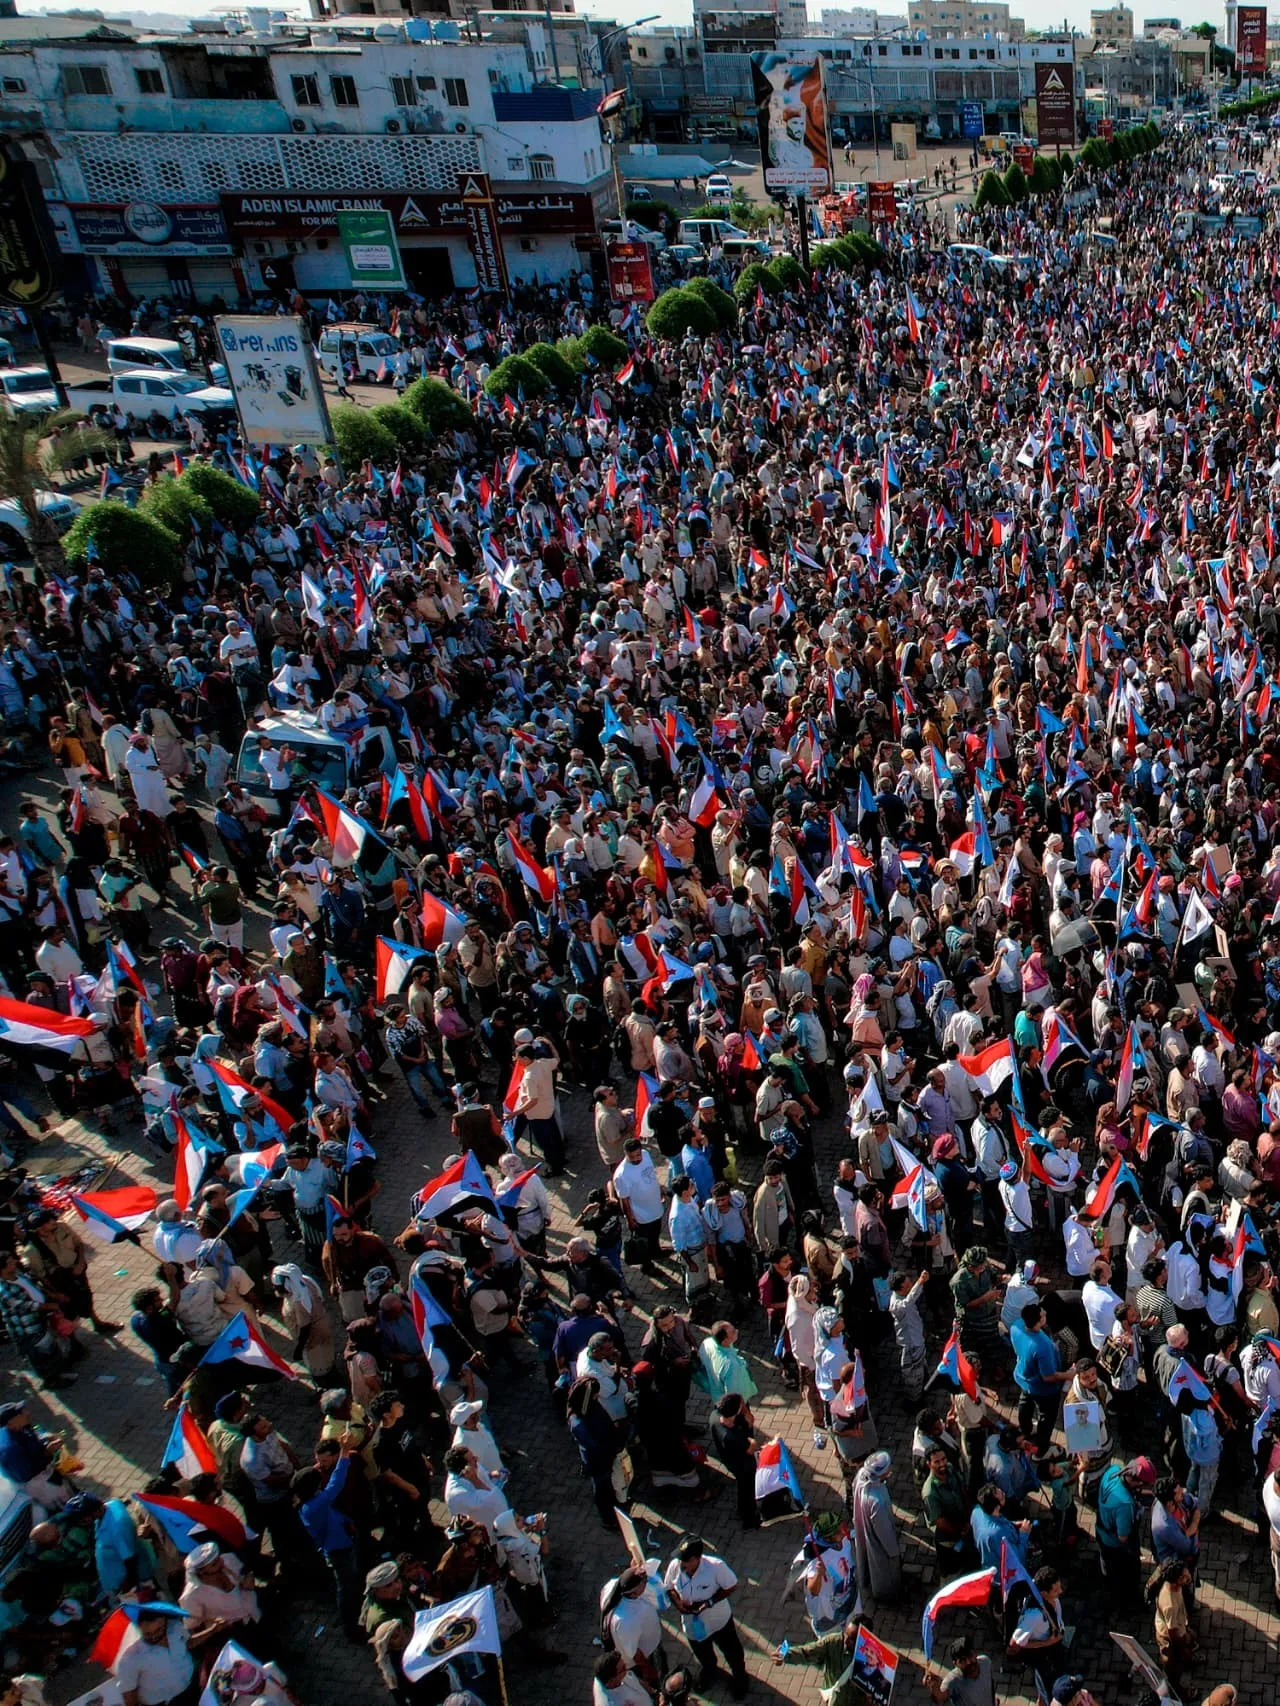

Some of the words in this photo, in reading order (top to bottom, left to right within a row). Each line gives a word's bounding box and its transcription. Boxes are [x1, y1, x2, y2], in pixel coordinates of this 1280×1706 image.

[241, 199, 283, 213] ADEN
[284, 199, 341, 213] ISLAMIC
[342, 199, 384, 210] BANK
[498, 198, 536, 213] عدن
[537, 196, 574, 213] بنك
[301, 216, 320, 226] FOR
[321, 216, 338, 226] MIC
